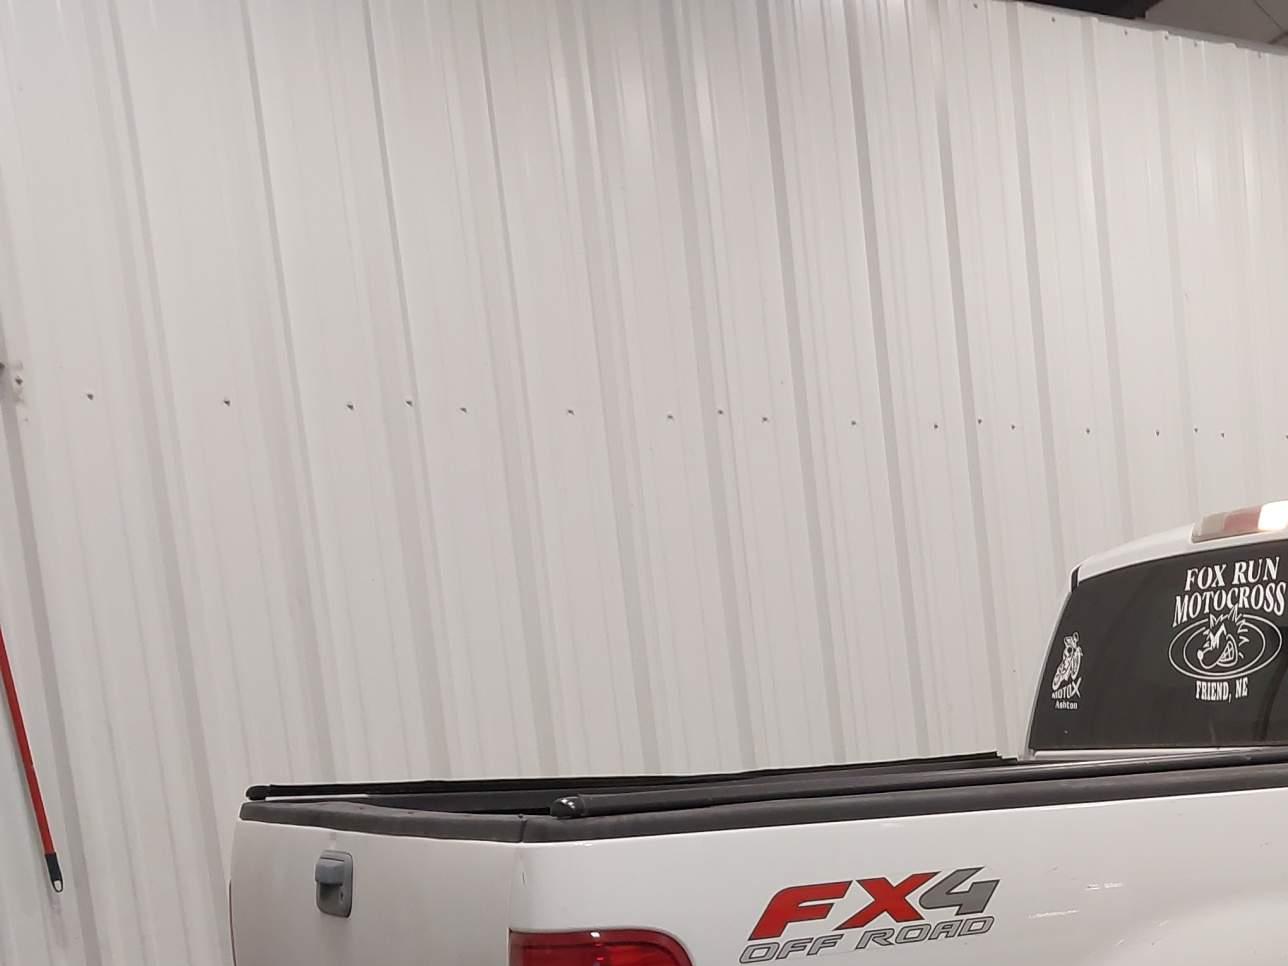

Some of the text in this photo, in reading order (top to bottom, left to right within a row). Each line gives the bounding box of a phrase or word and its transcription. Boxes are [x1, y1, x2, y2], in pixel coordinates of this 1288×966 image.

[1184, 556, 1280, 591] FOX RUN
[1172, 582, 1287, 628] MOTOCROSS
[1055, 700, 1078, 710] Ashton
[1195, 677, 1249, 703] FRIEND, NE
[748, 866, 1000, 941] FX4
[739, 916, 994, 964] OFF ROAD
